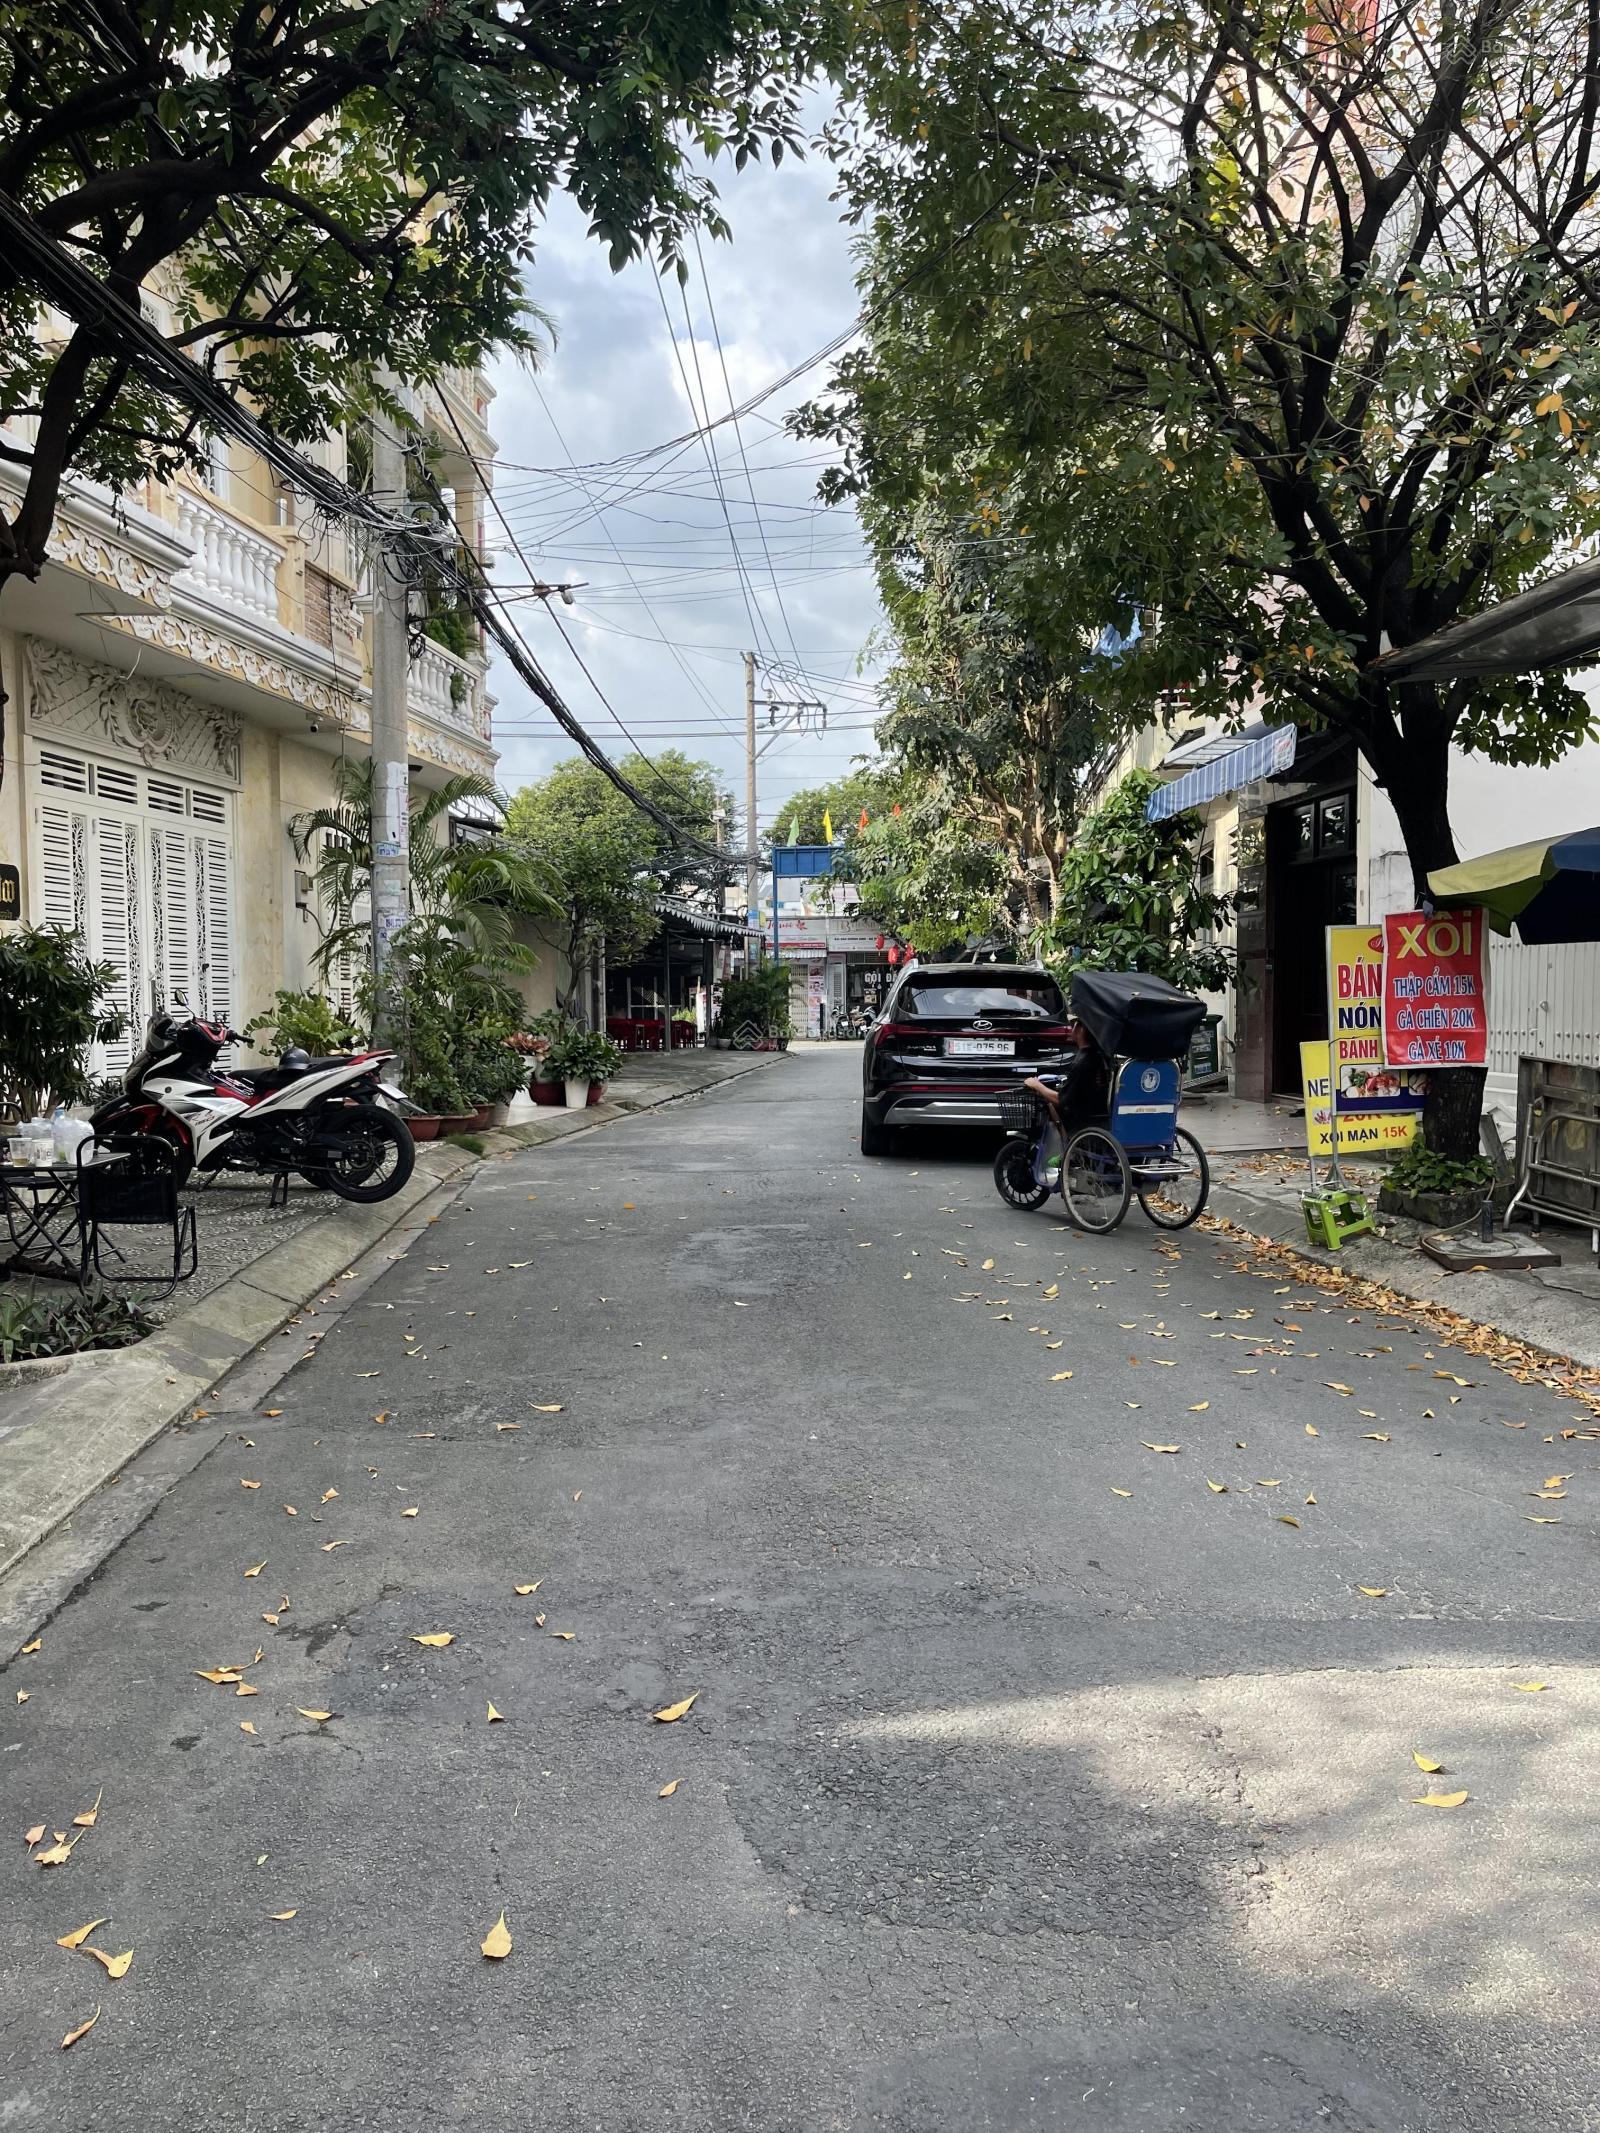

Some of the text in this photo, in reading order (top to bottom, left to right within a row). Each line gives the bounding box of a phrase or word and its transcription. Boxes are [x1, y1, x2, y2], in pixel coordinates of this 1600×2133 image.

[1393, 965, 1476, 1002] THẬP CẨM 15K
[1397, 1003, 1476, 1030] GÀ CHIÊN 20K
[1339, 1036, 1378, 1060] BÁNH
[1408, 1035, 1425, 1061] GÀ
[1444, 1040, 1466, 1060] 10K
[1383, 1125, 1408, 1138] 15K
